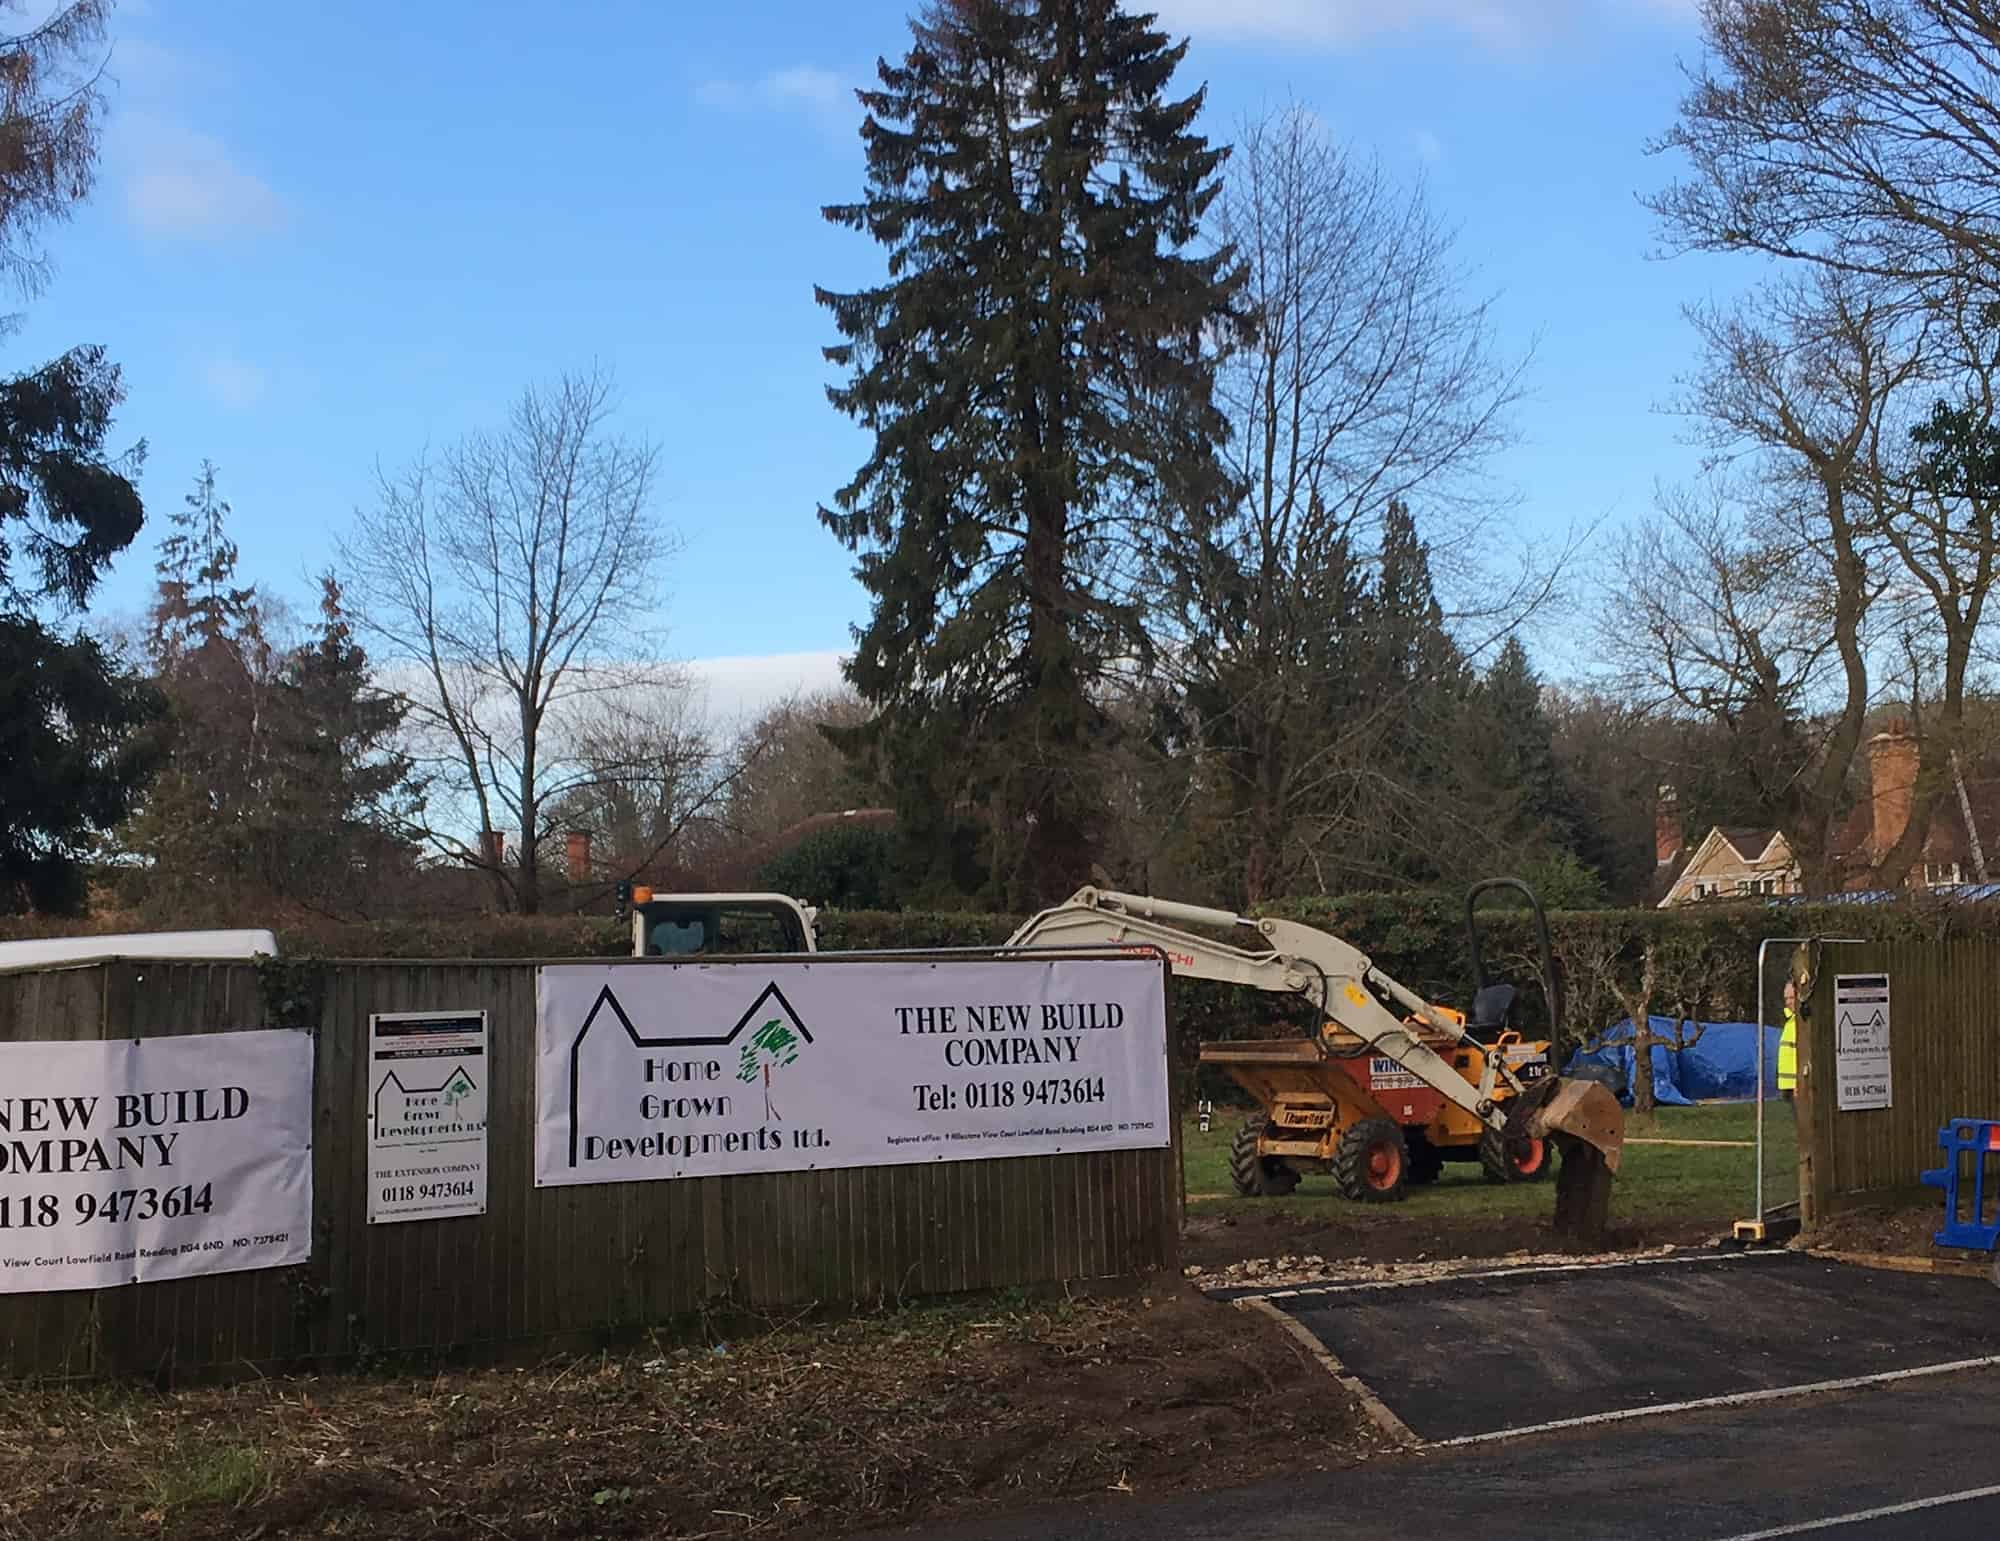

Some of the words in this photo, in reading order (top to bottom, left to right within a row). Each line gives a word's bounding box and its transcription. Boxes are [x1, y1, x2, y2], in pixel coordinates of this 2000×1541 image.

[895, 1006, 957, 1034] THE
[966, 1005, 1031, 1033] NEW
[1040, 1002, 1124, 1031] BUILD
[944, 1036, 1081, 1067] COMPANY
[643, 1058, 721, 1083] Home
[114, 1086, 250, 1129] BUILD
[640, 1094, 732, 1120] Grown
[913, 1084, 956, 1111] Tel:
[965, 1081, 1015, 1109] 0118
[1022, 1077, 1105, 1106] 9473614
[0, 1133, 179, 1174] MPANY
[584, 1126, 782, 1160] Developments
[793, 1128, 831, 1149] ltd.
[376, 1170, 392, 1179] THE
[395, 1167, 440, 1177] EXTENSION
[75, 1182, 213, 1226] 9473614
[382, 1185, 414, 1202] 0118
[420, 1180, 474, 1199] 9473614
[3, 1257, 31, 1267] View
[34, 1256, 63, 1265] Court
[66, 1253, 112, 1265] Lowfield
[115, 1249, 136, 1261] Road
[140, 1247, 178, 1257] Reading
[181, 1243, 200, 1253] RG4
[203, 1240, 224, 1250] 6ND
